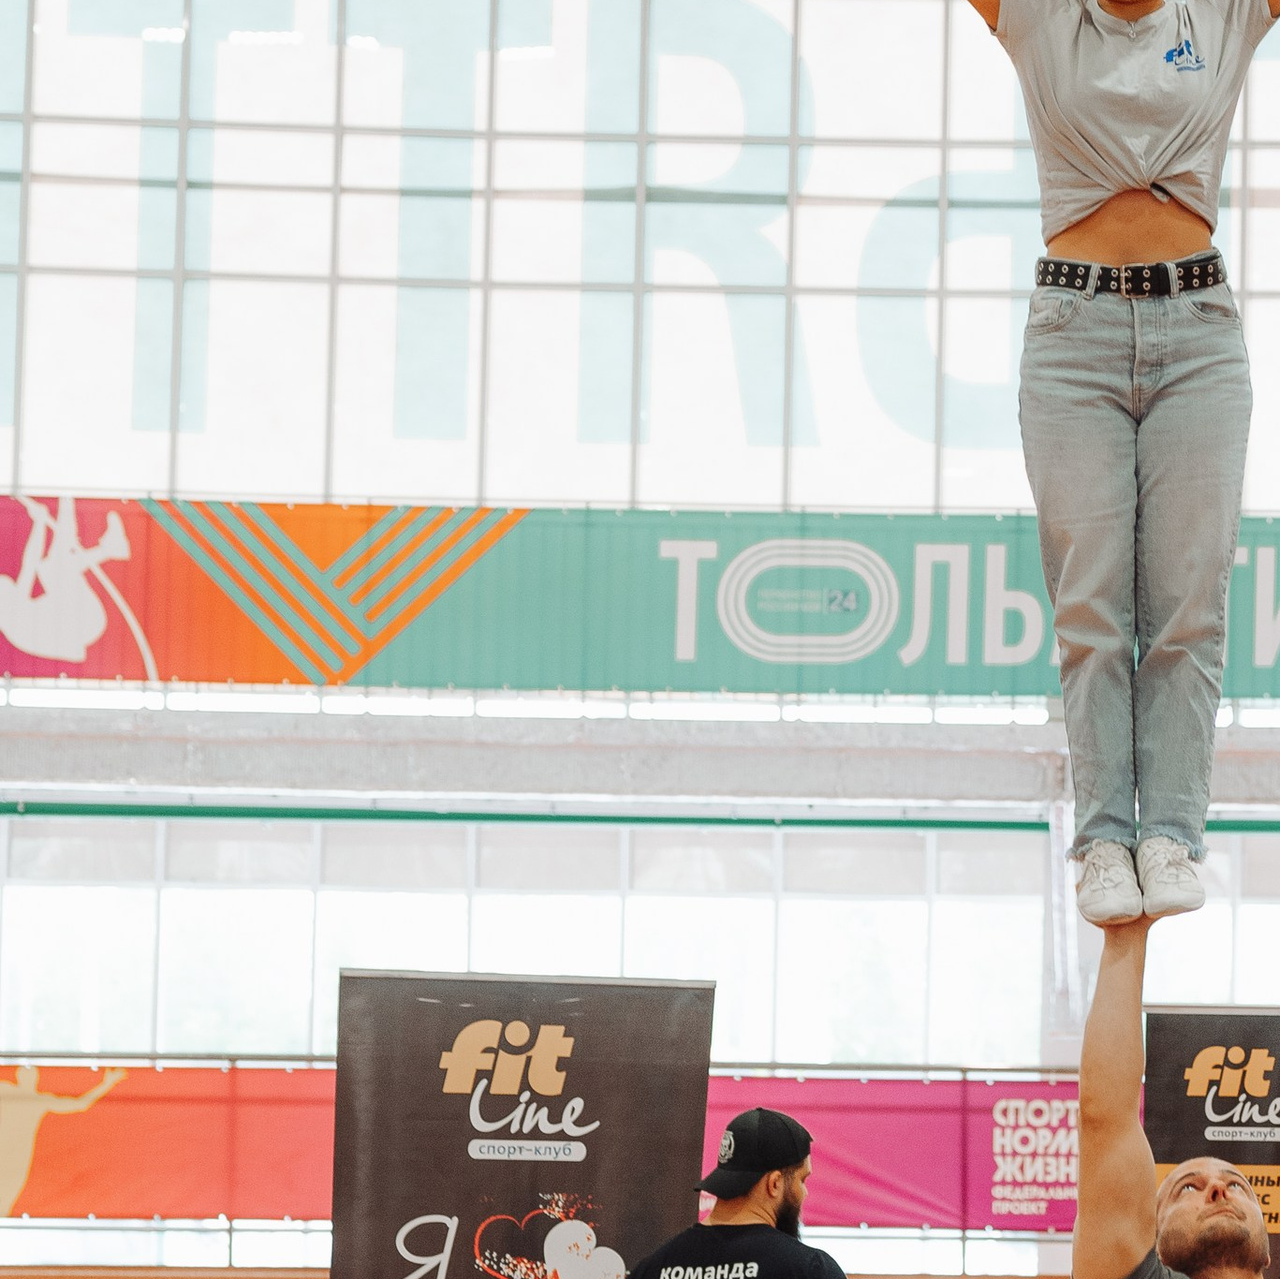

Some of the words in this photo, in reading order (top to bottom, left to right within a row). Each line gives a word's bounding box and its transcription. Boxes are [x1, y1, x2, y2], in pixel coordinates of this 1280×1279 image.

[438, 1019, 575, 1097] fit
[1184, 1045, 1276, 1098] fit
[469, 1078, 601, 1137] Line
[992, 1098, 1080, 1128] СПОРТ
[992, 1127, 1079, 1155] НОРМ
[1211, 1127, 1277, 1140] спорт-клуб
[478, 1142, 573, 1160] спорт-клуб
[992, 1154, 1078, 1183] ЖИЗН
